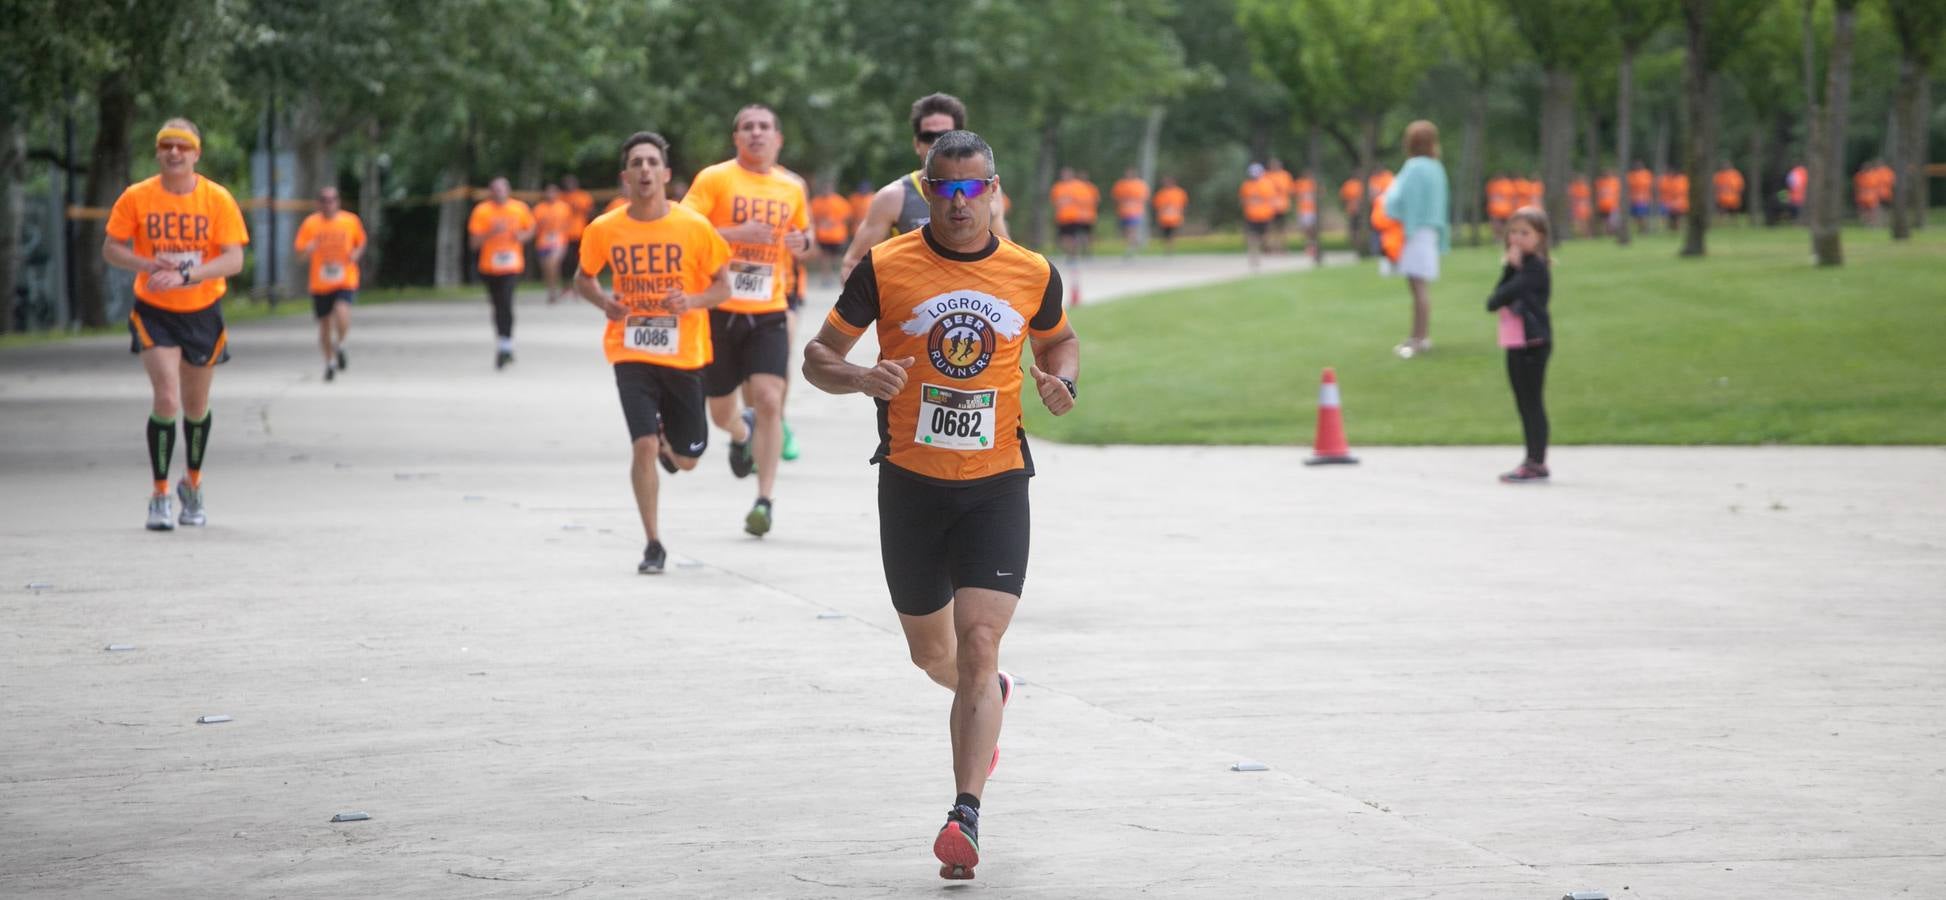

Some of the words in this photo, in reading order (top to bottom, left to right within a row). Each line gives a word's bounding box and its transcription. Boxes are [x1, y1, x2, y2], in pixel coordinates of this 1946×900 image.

[732, 195, 790, 228] BEER
[147, 211, 208, 241] BEER
[611, 243, 682, 275] BEER
[928, 297, 1001, 323] LOGROÑO
[942, 314, 985, 331] BEER
[634, 327, 669, 346] 0086
[931, 350, 990, 376] RUNNERS
[931, 407, 982, 437] 0682
